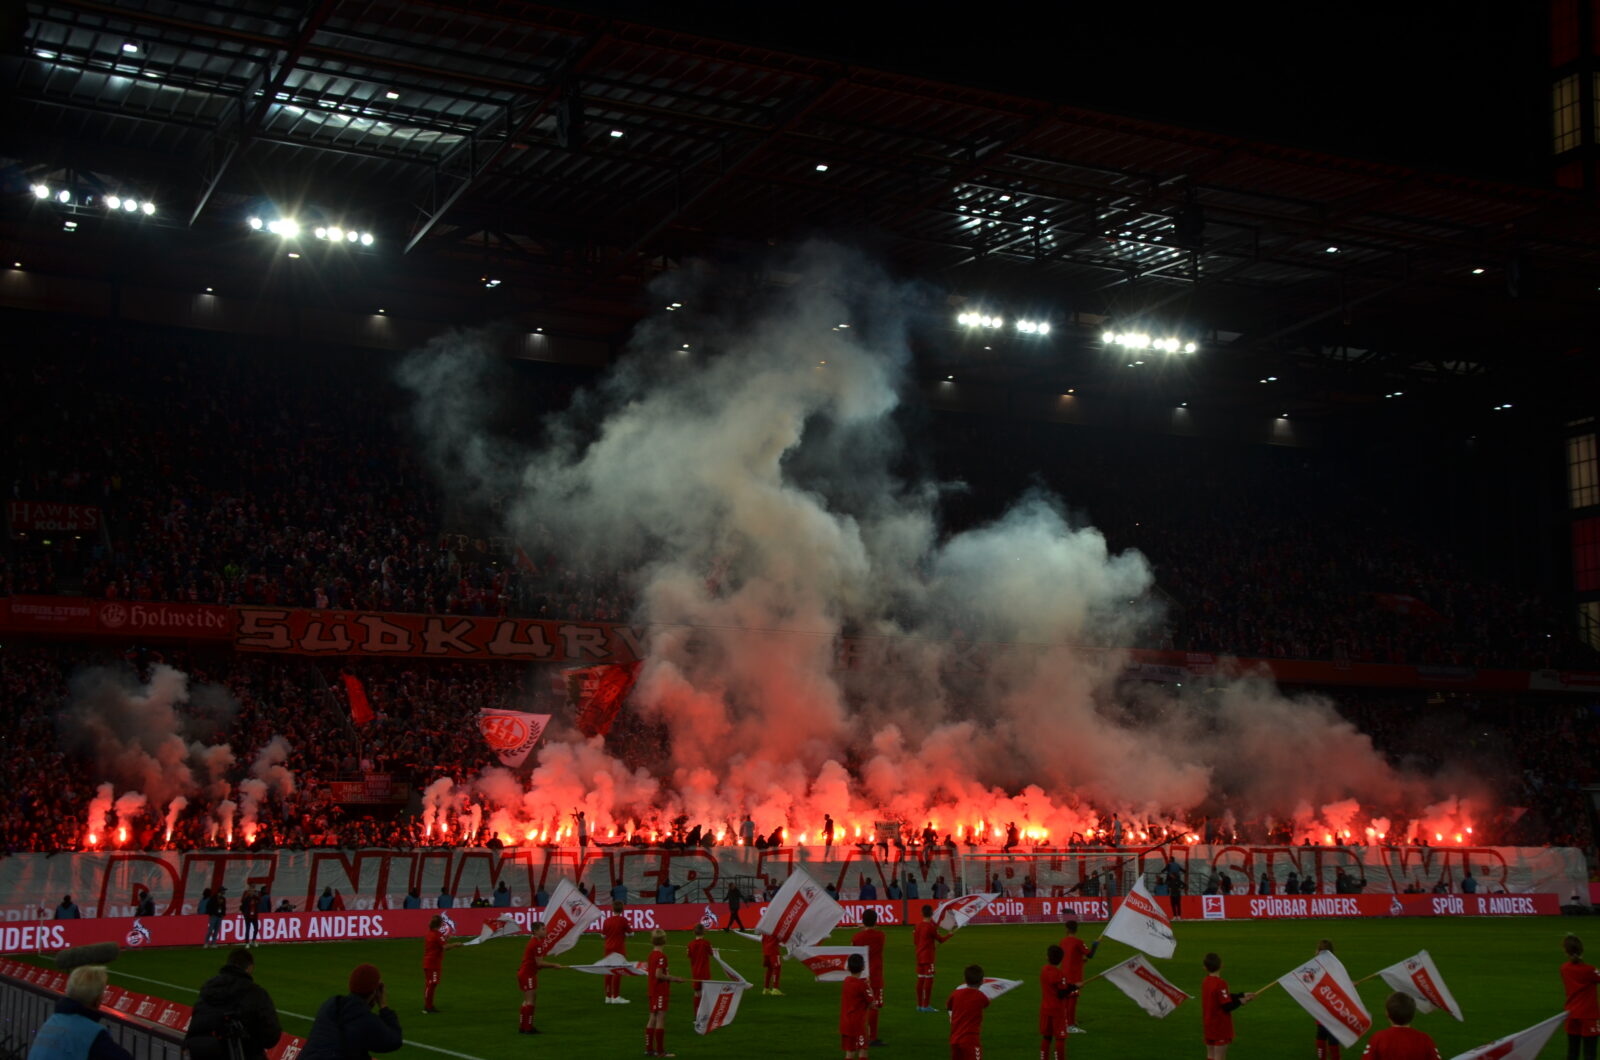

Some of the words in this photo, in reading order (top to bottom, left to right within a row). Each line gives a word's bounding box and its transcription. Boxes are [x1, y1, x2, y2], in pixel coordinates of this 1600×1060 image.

[130, 605, 226, 629] Holweide
[1250, 896, 1308, 917] SPÜRBAR
[1311, 897, 1362, 915] ANDERS.
[1432, 895, 1465, 914] SPÜR
[1489, 898, 1537, 914] ANDERS.
[307, 914, 389, 938] ANDERS.
